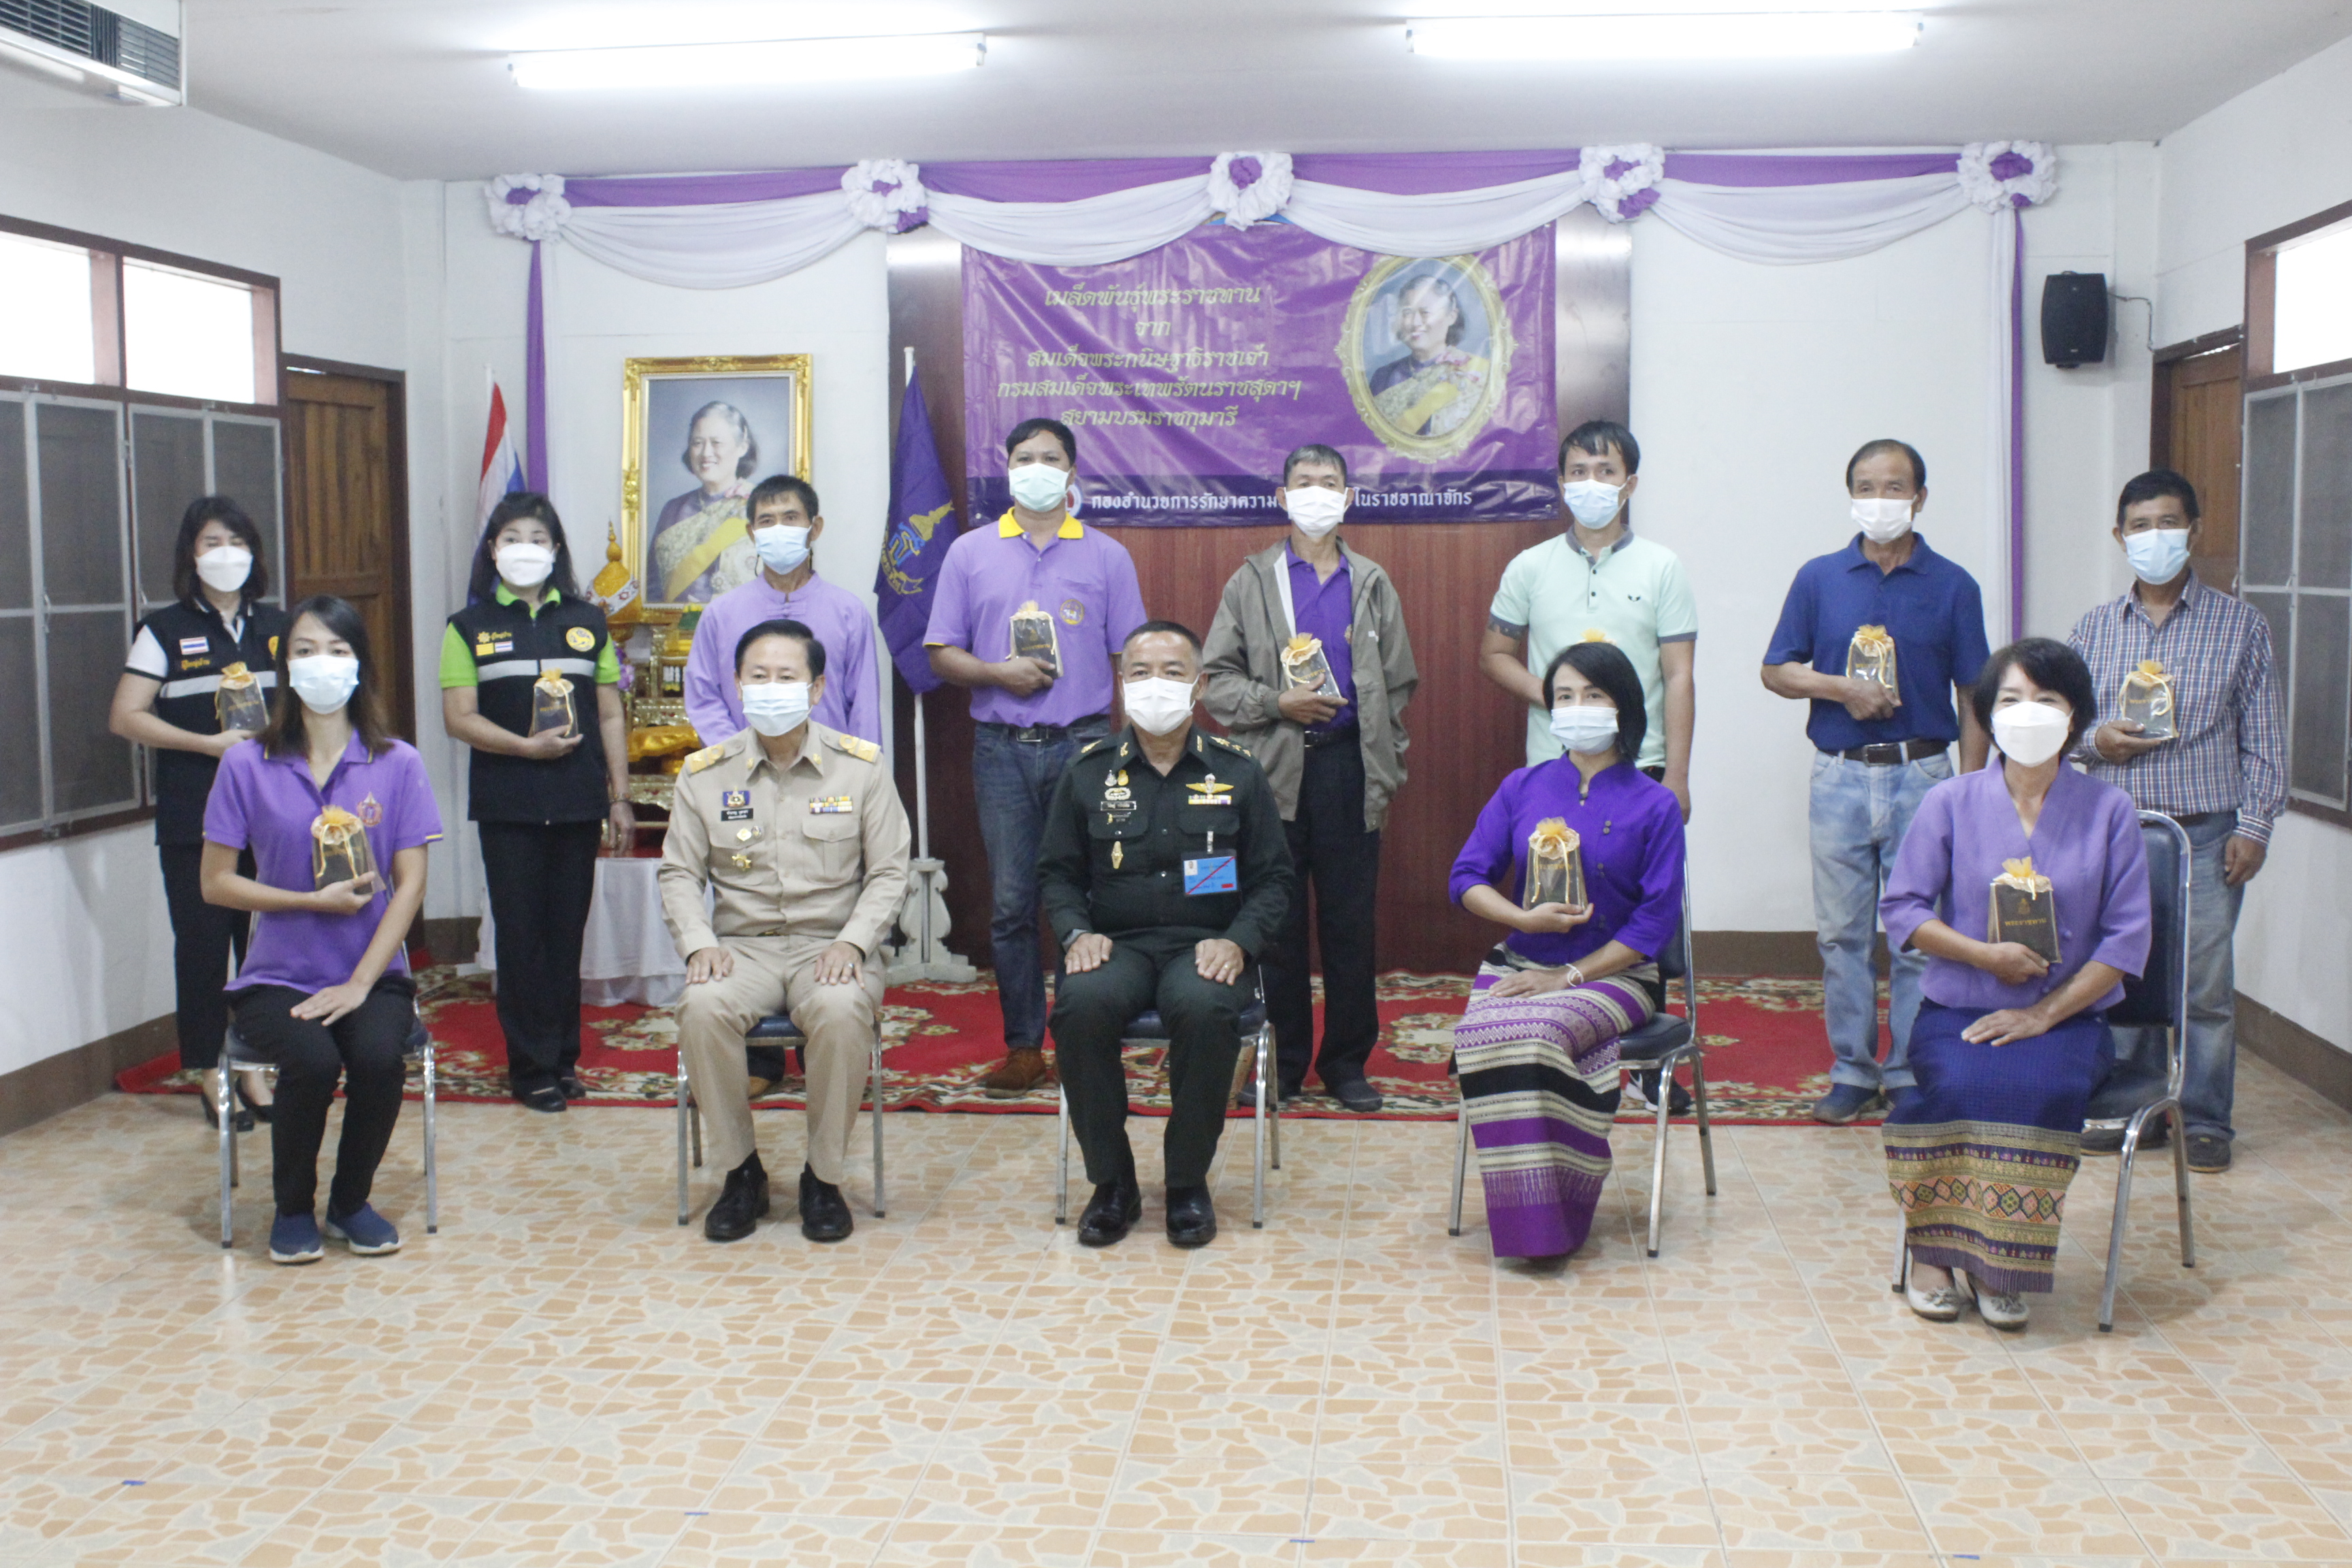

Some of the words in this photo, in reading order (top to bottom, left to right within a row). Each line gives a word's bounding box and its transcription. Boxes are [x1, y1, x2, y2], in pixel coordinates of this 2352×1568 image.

[1045, 281, 1261, 312] เมล็ดพันธุ์พระราชทาน
[1134, 321, 1171, 337] จาก
[1027, 344, 1269, 372] สมเด็จพระกนิษฐาธิราชเจ้า
[996, 372, 1303, 403] กรมสมเด็จพระเทพรัตนราชสุดาฯ
[1060, 405, 1239, 433] สยามบรมราชกุมารี
[1091, 491, 1281, 509] กองอำนวยการรักษาความ
